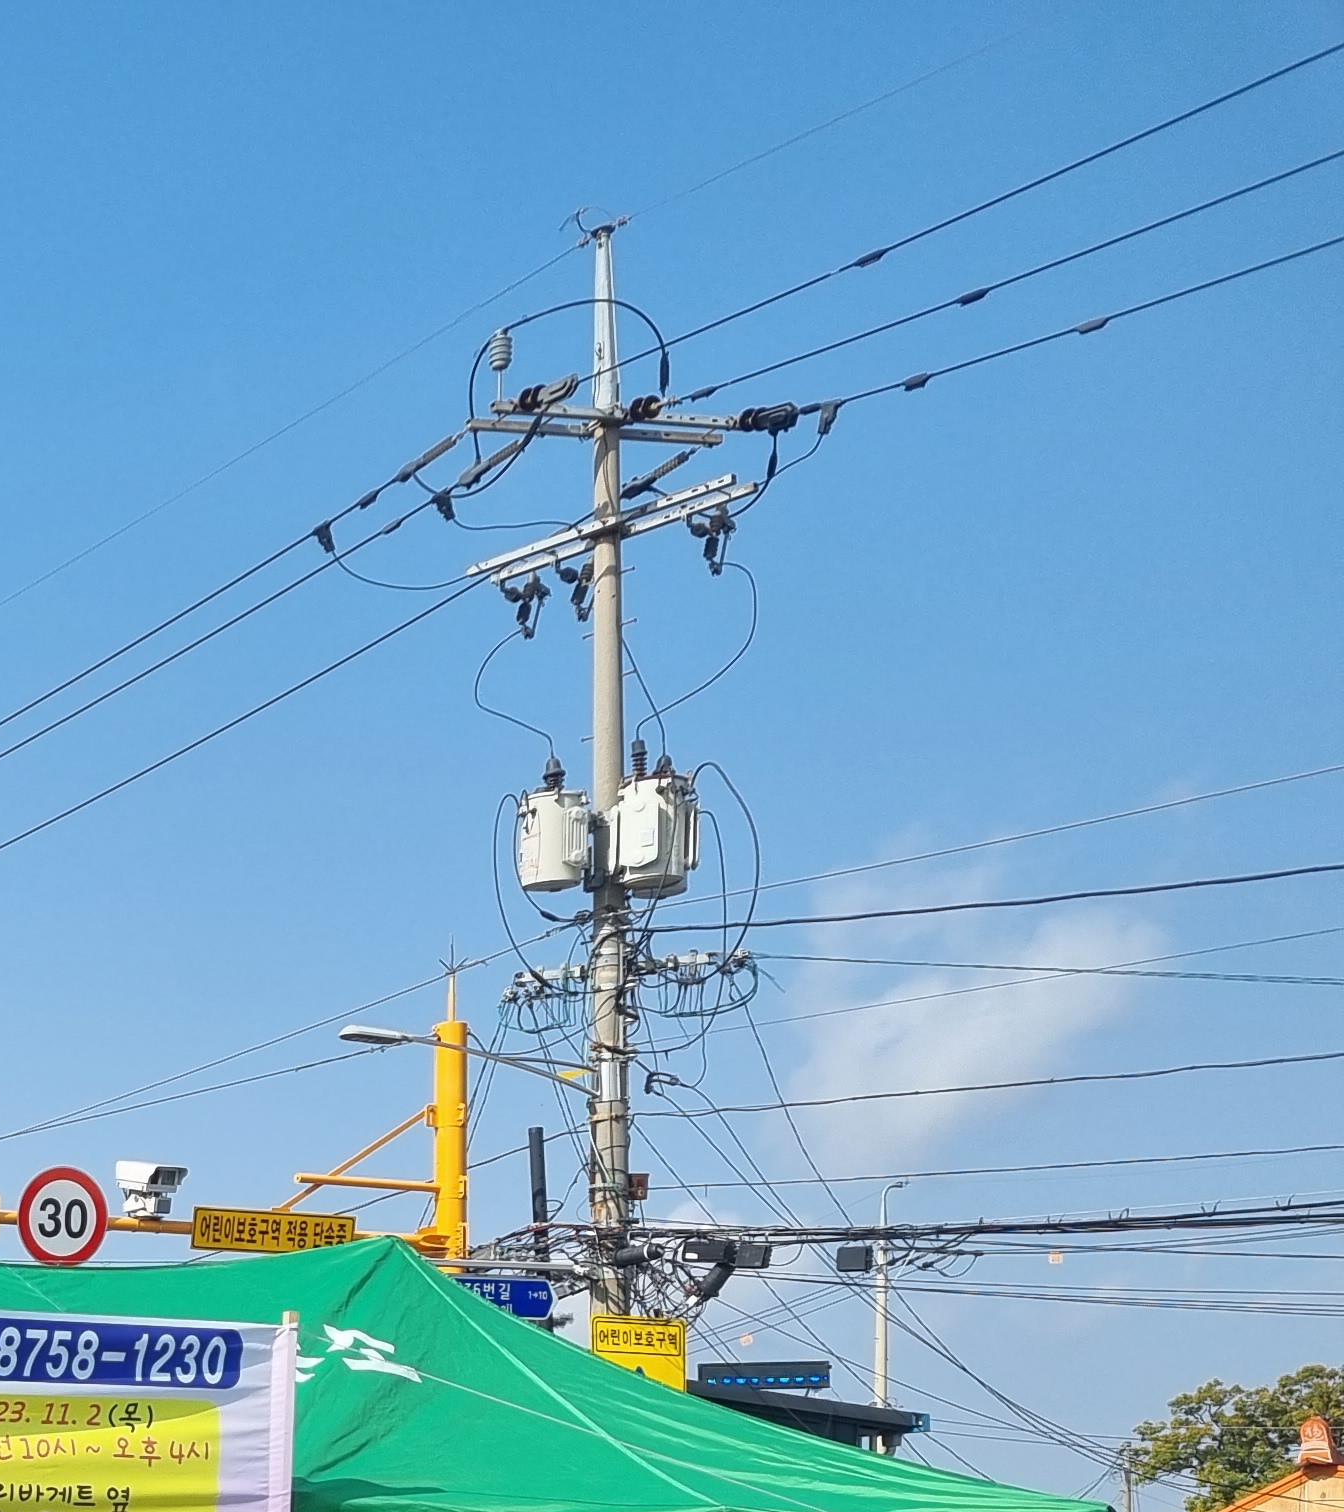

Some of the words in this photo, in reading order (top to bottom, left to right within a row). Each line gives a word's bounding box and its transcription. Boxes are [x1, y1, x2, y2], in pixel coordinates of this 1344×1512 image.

[37, 1198, 88, 1239] 30
[200, 1215, 282, 1247] 어린이보호구역
[286, 1220, 309, 1248] 적용
[598, 1328, 679, 1349] 어린이보호구역
